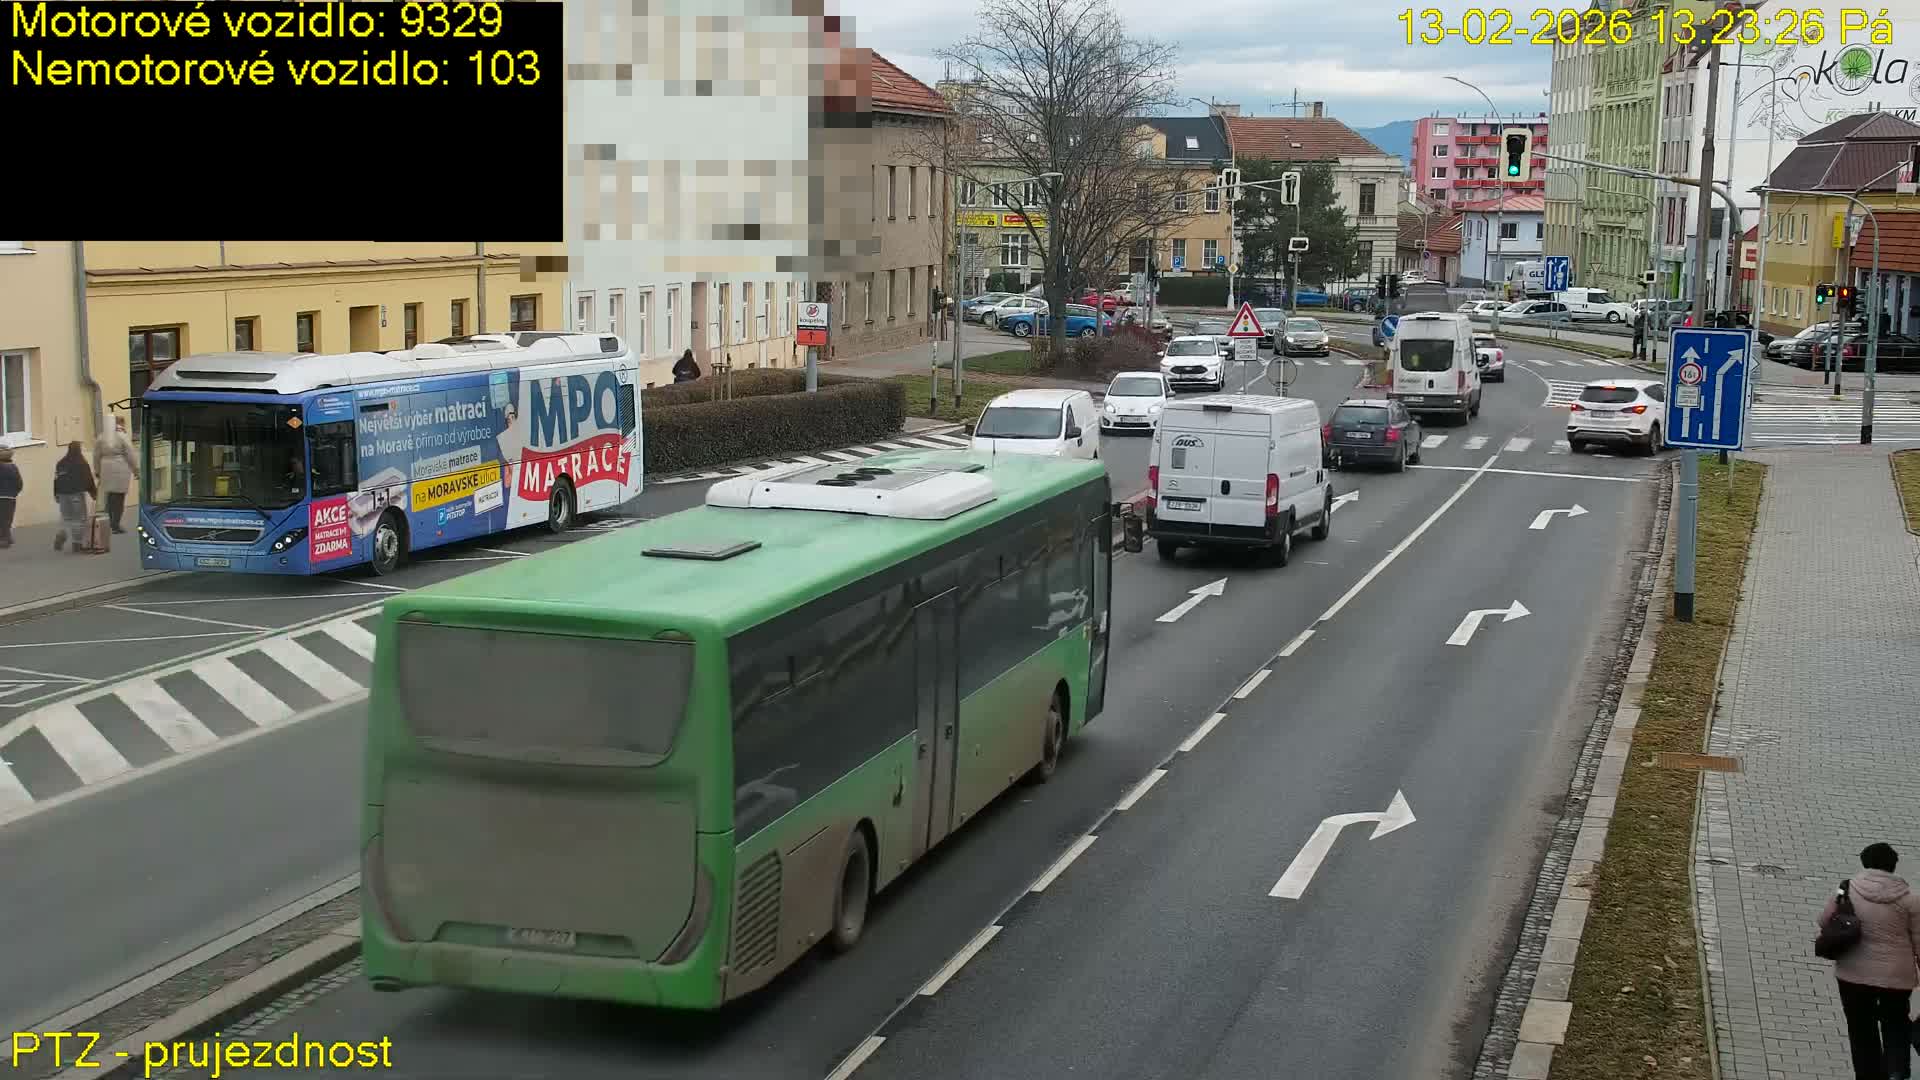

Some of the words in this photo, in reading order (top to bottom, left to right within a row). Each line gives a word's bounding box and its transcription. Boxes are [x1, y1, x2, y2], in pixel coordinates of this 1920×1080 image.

[435, 395, 487, 424] matrací
[530, 370, 621, 448] MPO
[360, 443, 375, 457] na
[376, 435, 414, 454] Moravě
[415, 430, 443, 449] přímo
[444, 429, 457, 445] od
[458, 425, 491, 445] výrobce
[448, 452, 479, 469] matrace
[523, 442, 626, 493] MATRACE
[415, 492, 427, 504] na
[314, 505, 347, 527] AKCE
[315, 530, 340, 541] MATRACE
[314, 539, 349, 555] ZDARMA
